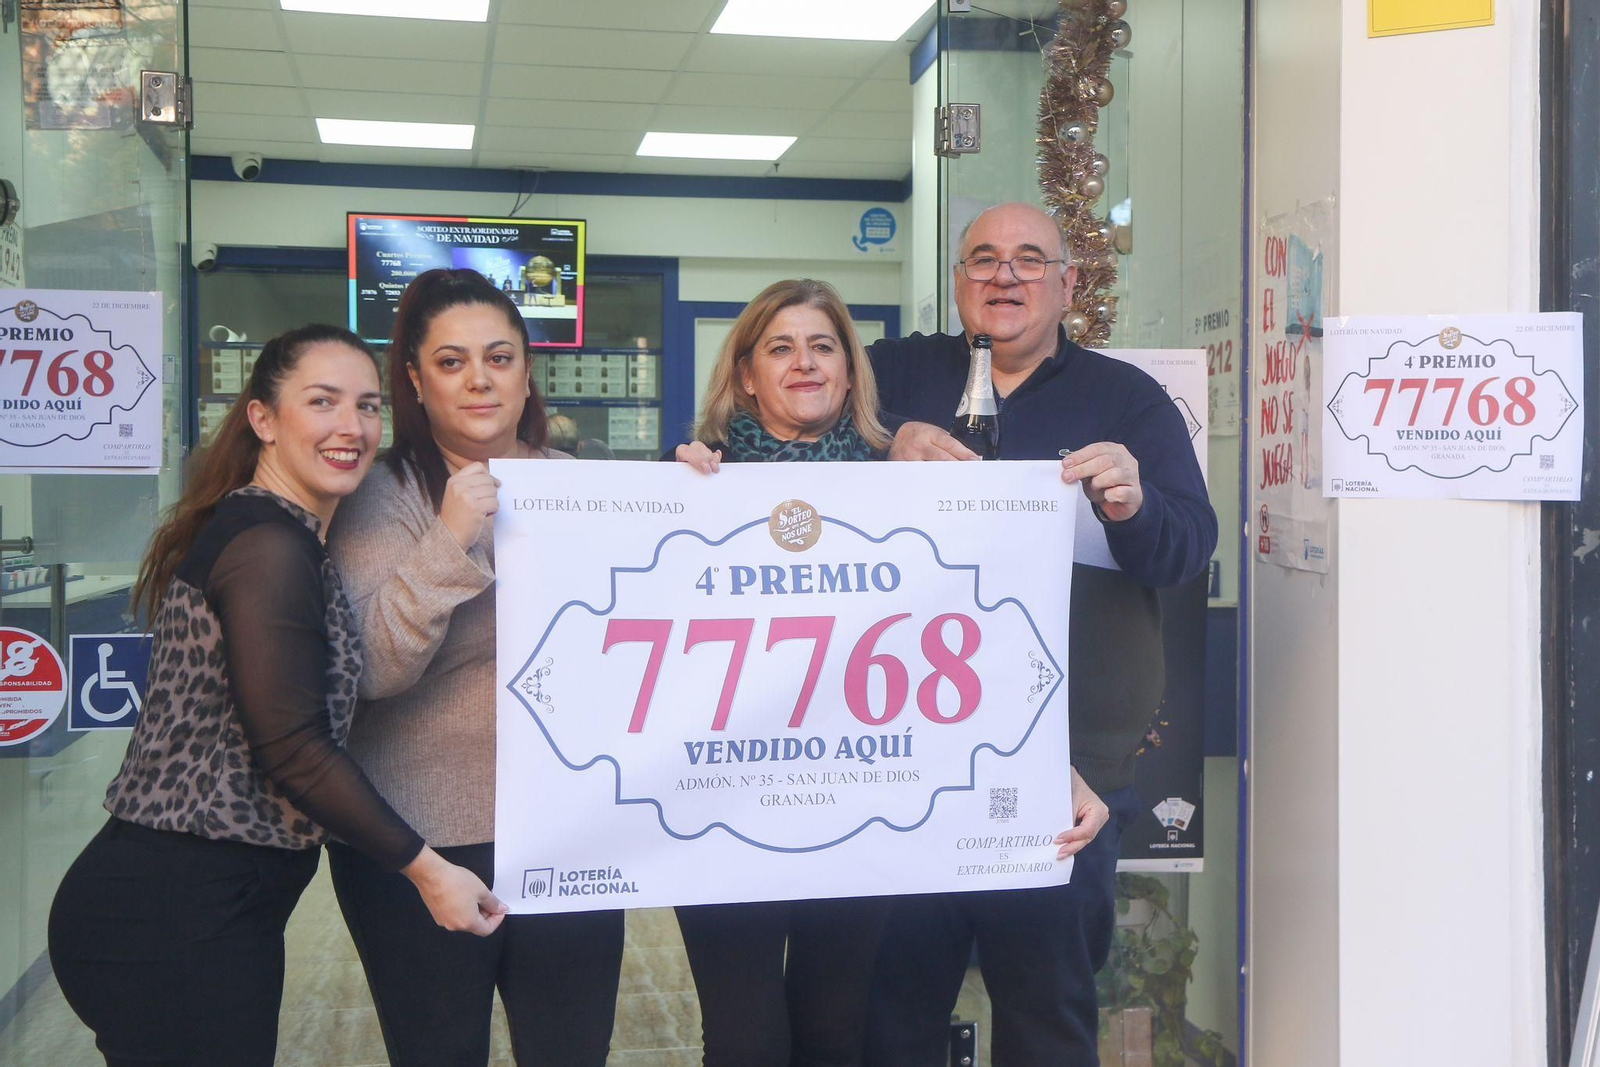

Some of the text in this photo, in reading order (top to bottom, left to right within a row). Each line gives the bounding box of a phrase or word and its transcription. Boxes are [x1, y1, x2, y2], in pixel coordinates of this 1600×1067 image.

[437, 234, 500, 244] DE NAVIDAD
[450, 227, 519, 235] EXTRAORDINARIO
[1265, 236, 1287, 278] CON
[1263, 288, 1275, 333] EL
[1204, 309, 1229, 333] PREMIO
[0, 327, 74, 341] PREMIO
[1200, 339, 1232, 376] 212
[1262, 340, 1296, 386] JUEGO
[1419, 355, 1496, 369] PREMIO
[0, 350, 114, 397] 768
[44, 397, 81, 412] AQUÍ
[1363, 376, 1536, 426] 77768
[1261, 390, 1294, 438] NO SE
[1396, 426, 1502, 442] VENDIDO AQUÍ
[1260, 443, 1293, 490] JUEGA
[514, 496, 685, 514] LOTERÍA DE NAVIDAD
[938, 500, 1058, 512] 22 DE DICIEMBRE
[779, 509, 812, 528] SORTEO
[782, 530, 795, 541] NOS
[797, 524, 812, 536] UNE
[729, 562, 900, 595] PREMIO
[602, 612, 982, 733] 77768
[683, 726, 913, 766] VENDIDO AQUÍ
[675, 773, 735, 791] ADMÓN.
[759, 774, 774, 787] 35
[787, 773, 818, 786] SAN
[820, 772, 859, 785] JUAN
[862, 771, 882, 784] DE
[884, 770, 920, 783] DIOS
[760, 794, 836, 807] GRANADA
[956, 835, 1053, 850] COMPARTIRLO
[559, 866, 622, 883] LOTERÍA
[957, 862, 1052, 875] EXTRAORDINARIO
[558, 882, 639, 896] NACIONAL
